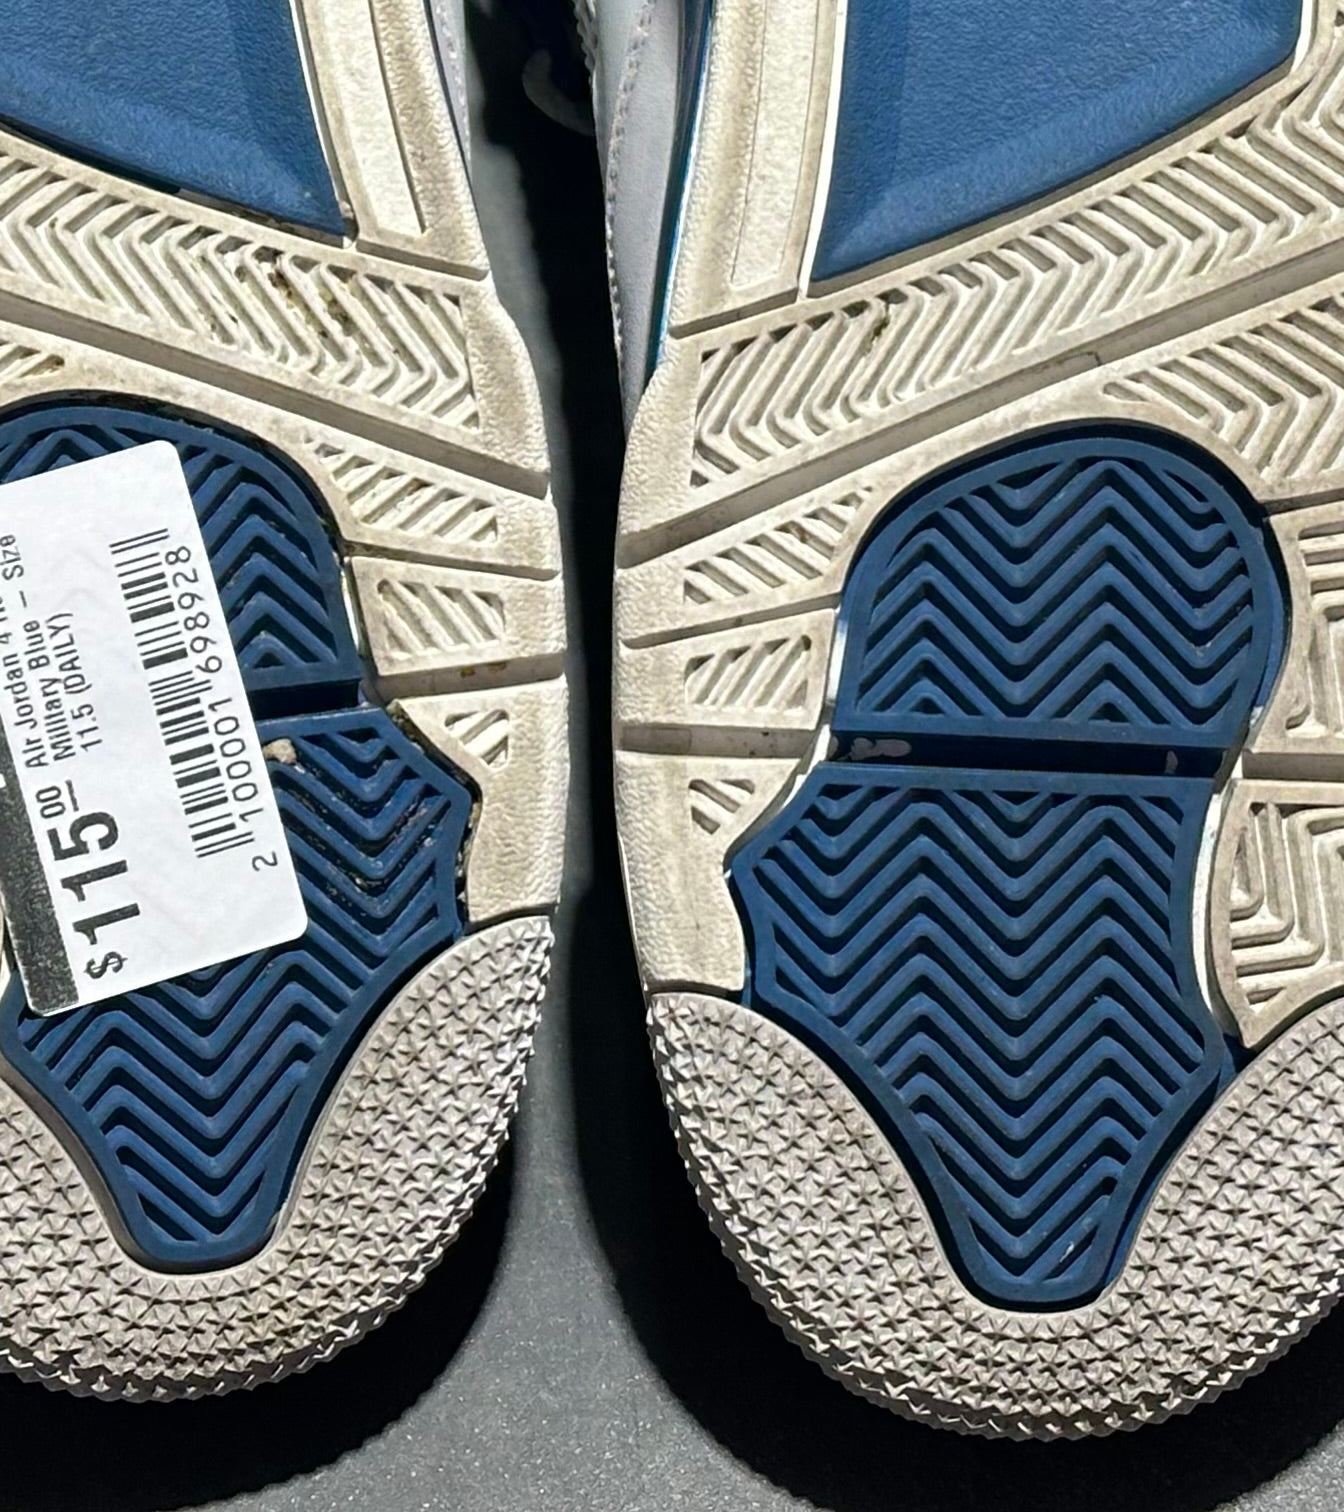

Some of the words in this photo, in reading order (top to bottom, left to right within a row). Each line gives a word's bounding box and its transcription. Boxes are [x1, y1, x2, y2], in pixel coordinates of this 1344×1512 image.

[22, 619, 51, 671] Blue
[45, 612, 93, 696] (DAILY)
[2, 652, 38, 731] Jordan
[39, 677, 77, 762] Military
[21, 736, 50, 769] Air
[71, 703, 103, 753] 11.5
